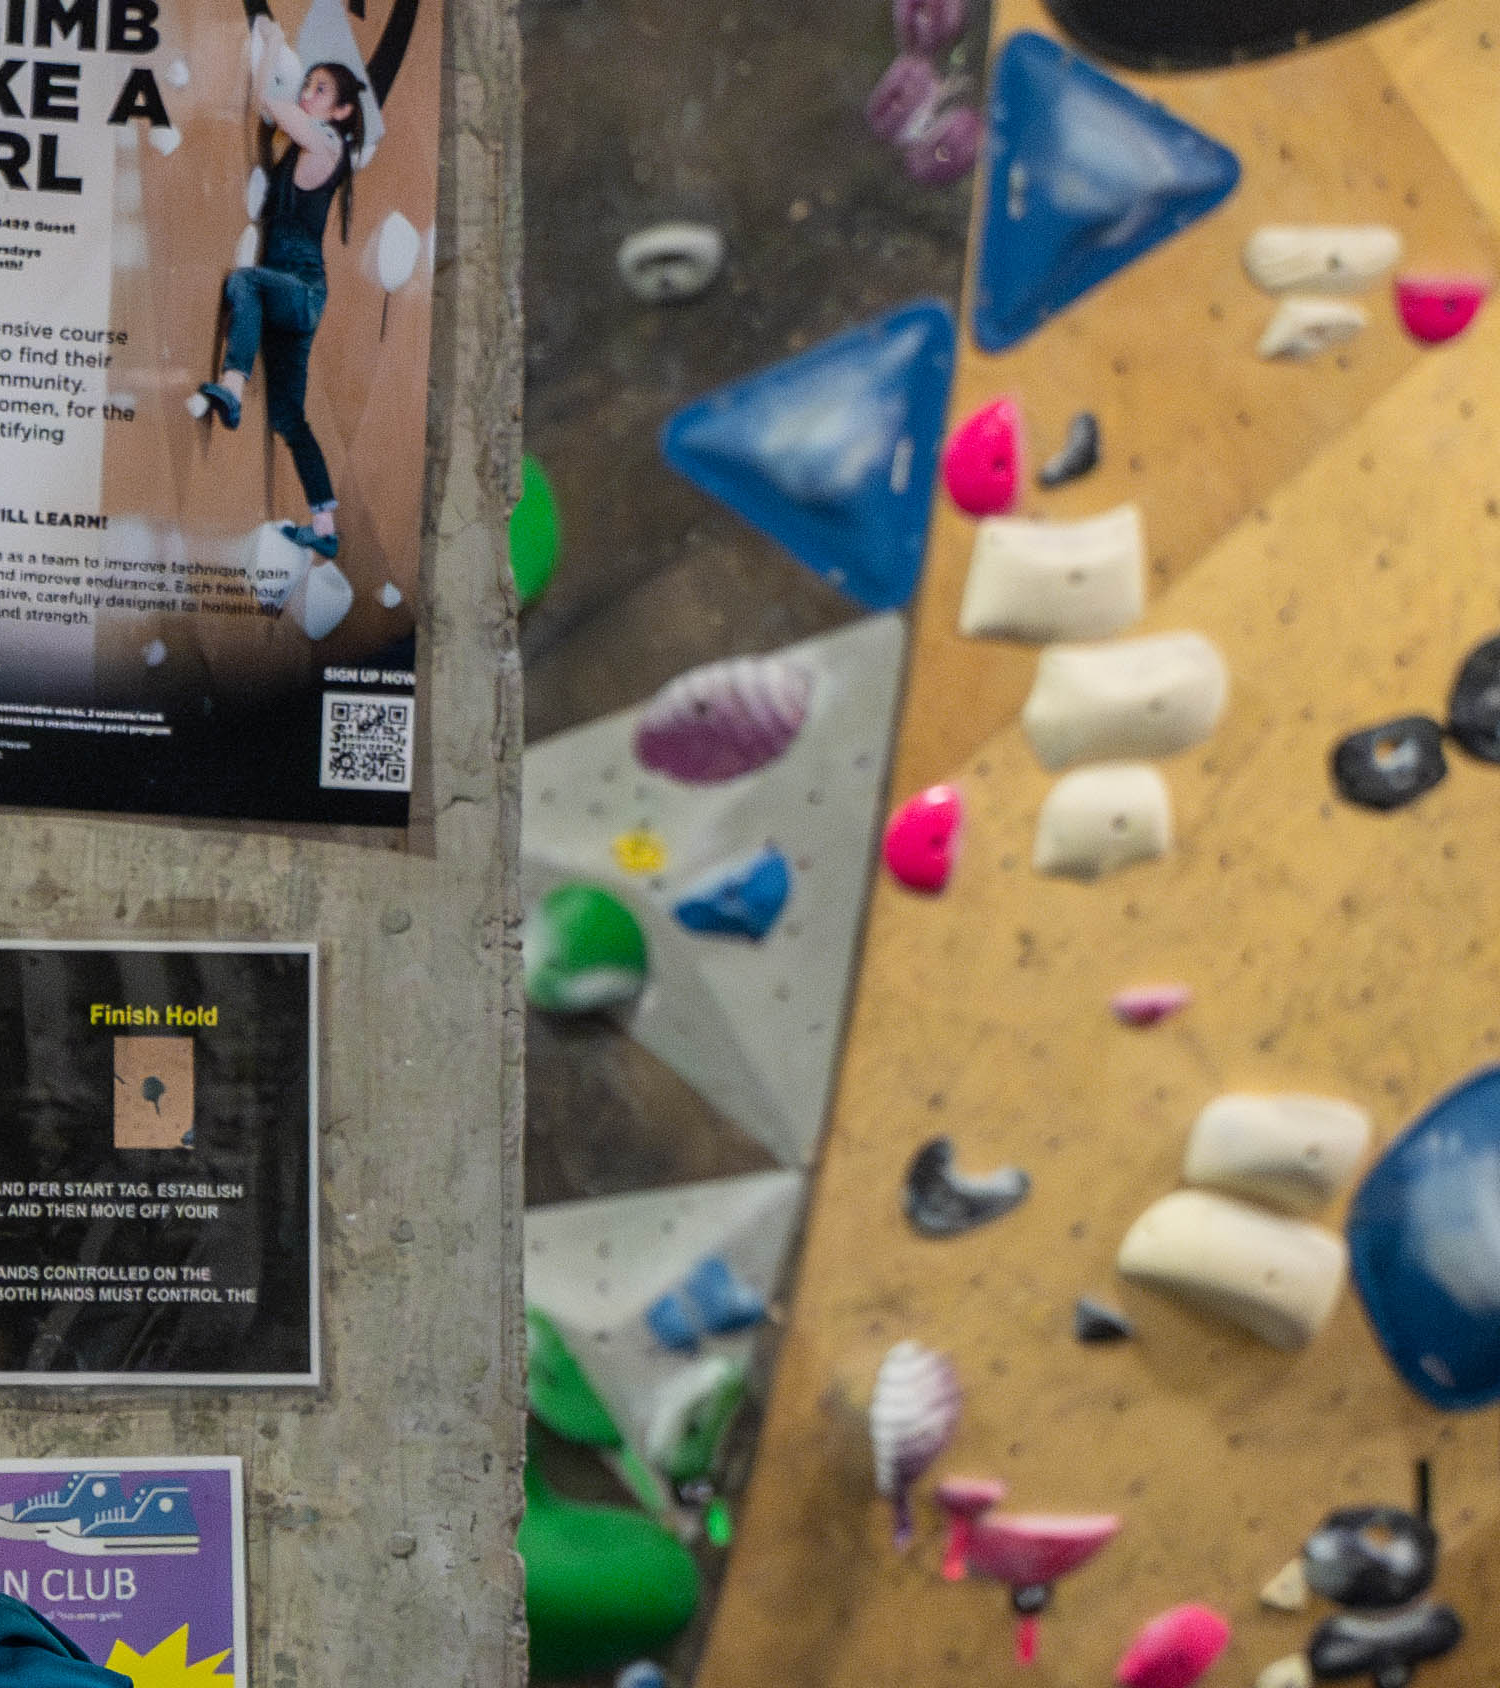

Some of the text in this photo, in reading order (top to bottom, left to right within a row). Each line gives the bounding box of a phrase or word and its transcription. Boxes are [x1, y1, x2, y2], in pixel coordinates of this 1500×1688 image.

[107, 68, 172, 128] A
[34, 220, 76, 234] Guest
[59, 327, 128, 346] course
[19, 346, 59, 366] find
[64, 351, 113, 369] their
[66, 402, 96, 419] for
[101, 403, 136, 423] the
[7, 552, 24, 564] as
[28, 553, 37, 564] a
[41, 552, 80, 568] team
[83, 555, 100, 569] to
[103, 557, 167, 576] improve
[19, 570, 81, 588] improve
[36, 591, 101, 609] carefully
[105, 593, 177, 614] designed
[323, 666, 359, 683] SIGN
[360, 668, 380, 684] UP
[90, 1003, 218, 1026] Finish Hold
[28, 1181, 62, 1197] PER
[63, 1181, 115, 1198] START
[156, 1182, 244, 1199] ESTABLISH
[6, 1202, 42, 1218] AND
[45, 1202, 88, 1219] THEN
[90, 1203, 136, 1219] MOVE
[139, 1203, 171, 1219] OFF
[174, 1204, 219, 1220] YOUR
[43, 1265, 150, 1282] CONTROLLED
[153, 1265, 177, 1282] ON
[179, 1265, 213, 1282] THE
[41, 1286, 96, 1302] HANDS
[98, 1286, 143, 1302] MUST
[146, 1287, 223, 1304] CONTROL
[225, 1287, 258, 1304] THE
[40, 1567, 138, 1602] CLUB
